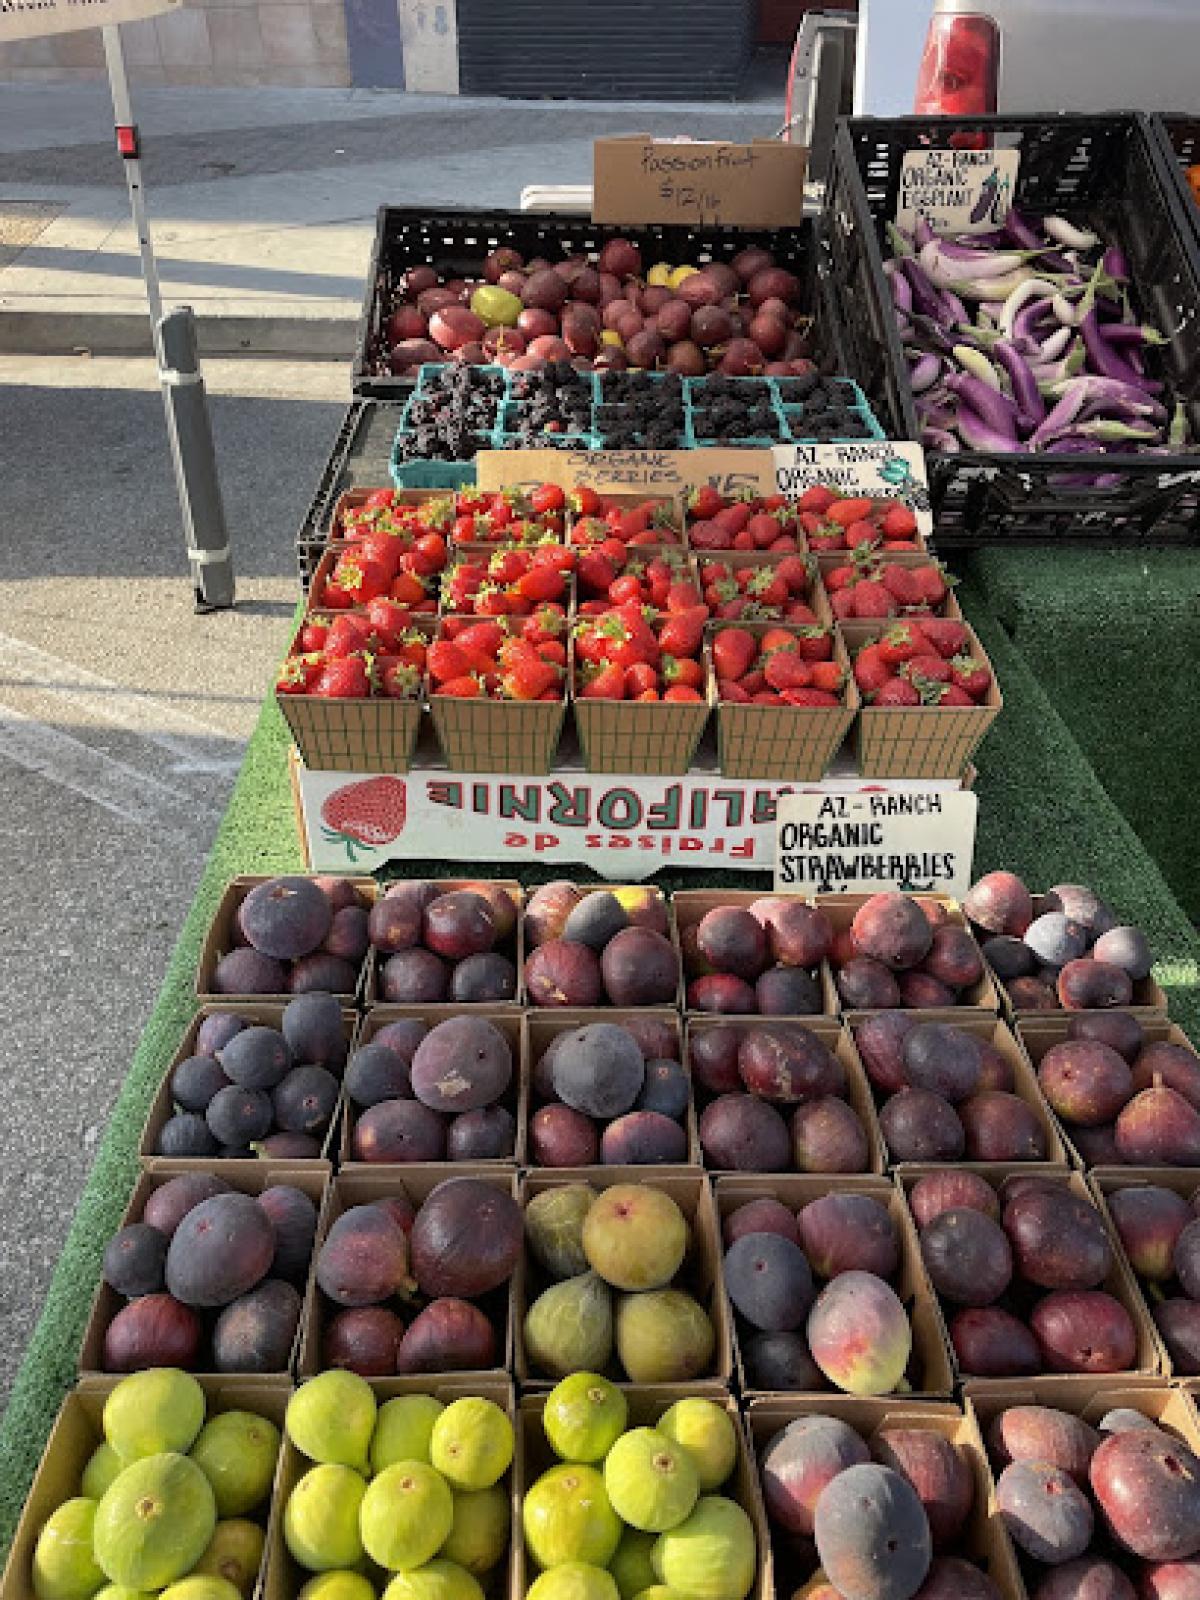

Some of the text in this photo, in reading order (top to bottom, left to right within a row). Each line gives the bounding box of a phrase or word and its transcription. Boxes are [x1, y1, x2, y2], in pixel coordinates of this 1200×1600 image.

[902, 166, 968, 188] ORGANIC
[902, 187, 975, 209] EGGPLANT
[502, 831, 755, 859] Fraises de
[779, 822, 883, 851] ORGANIC
[779, 852, 956, 883] STRAWBERRIES
